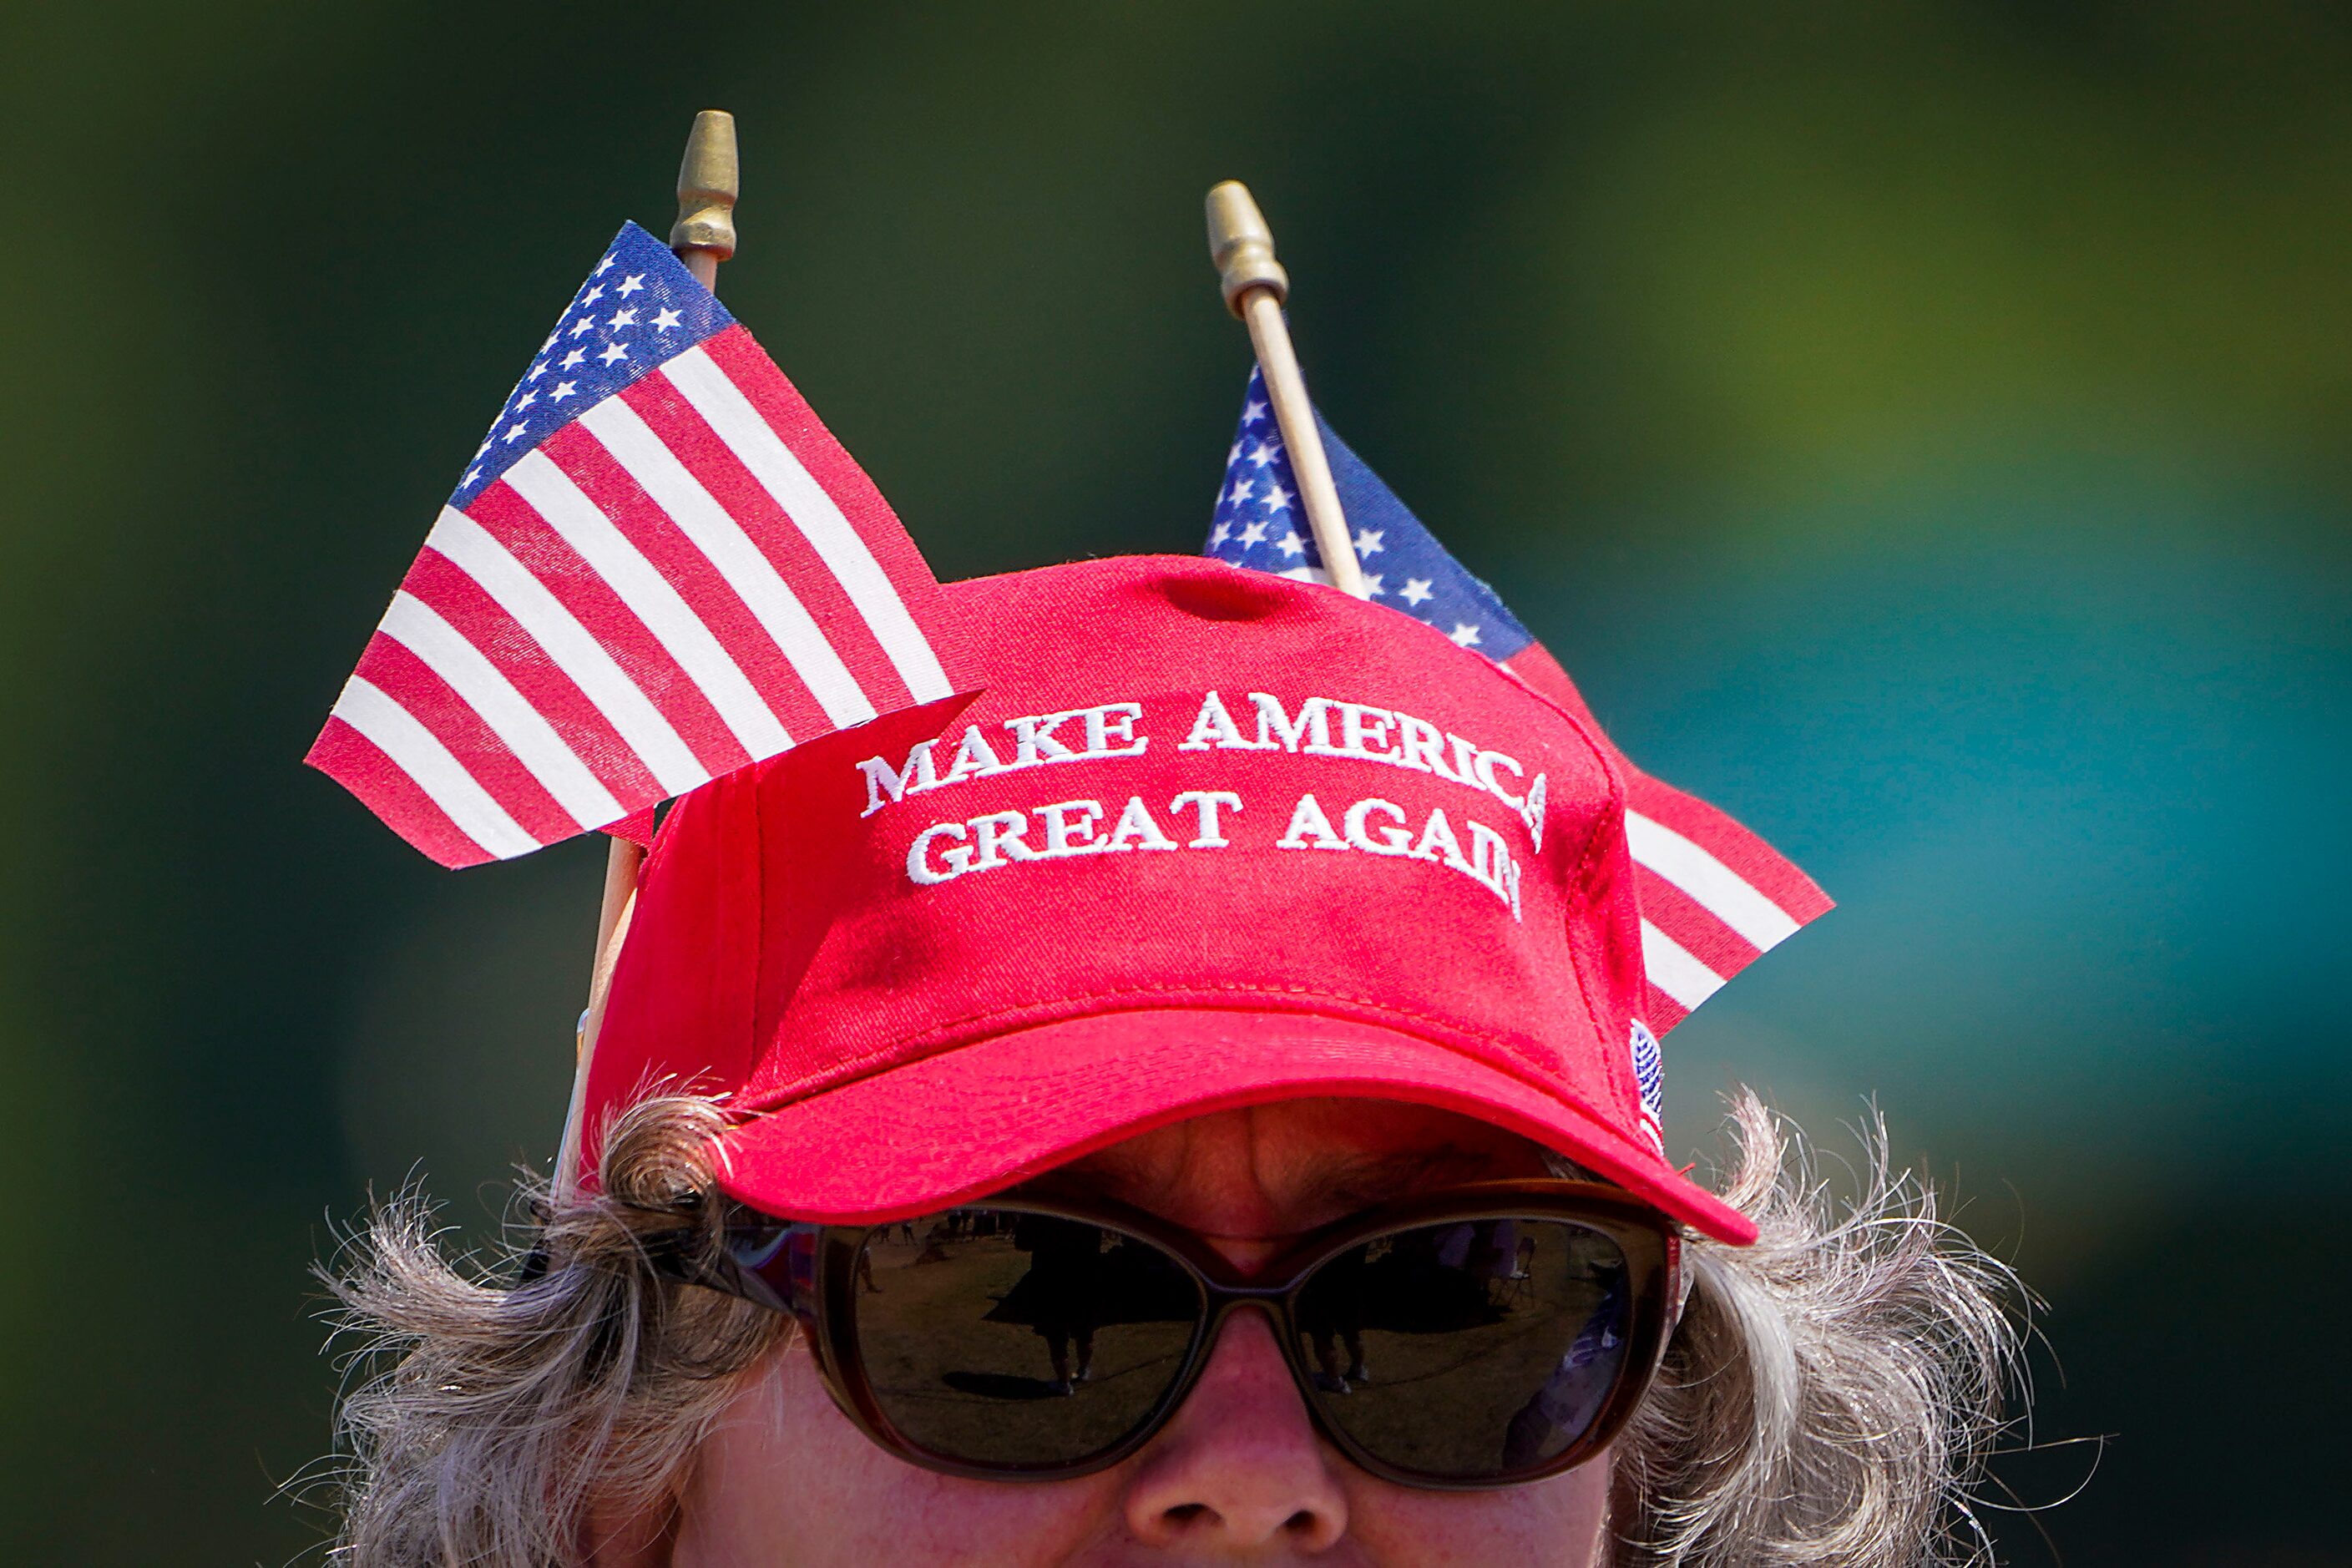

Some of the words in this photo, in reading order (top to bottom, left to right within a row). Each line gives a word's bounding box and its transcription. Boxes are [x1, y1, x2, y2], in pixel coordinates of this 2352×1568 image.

[856, 702, 1149, 818] MAKE
[1178, 690, 1547, 855] AMERICA
[906, 792, 1243, 886] GREAT
